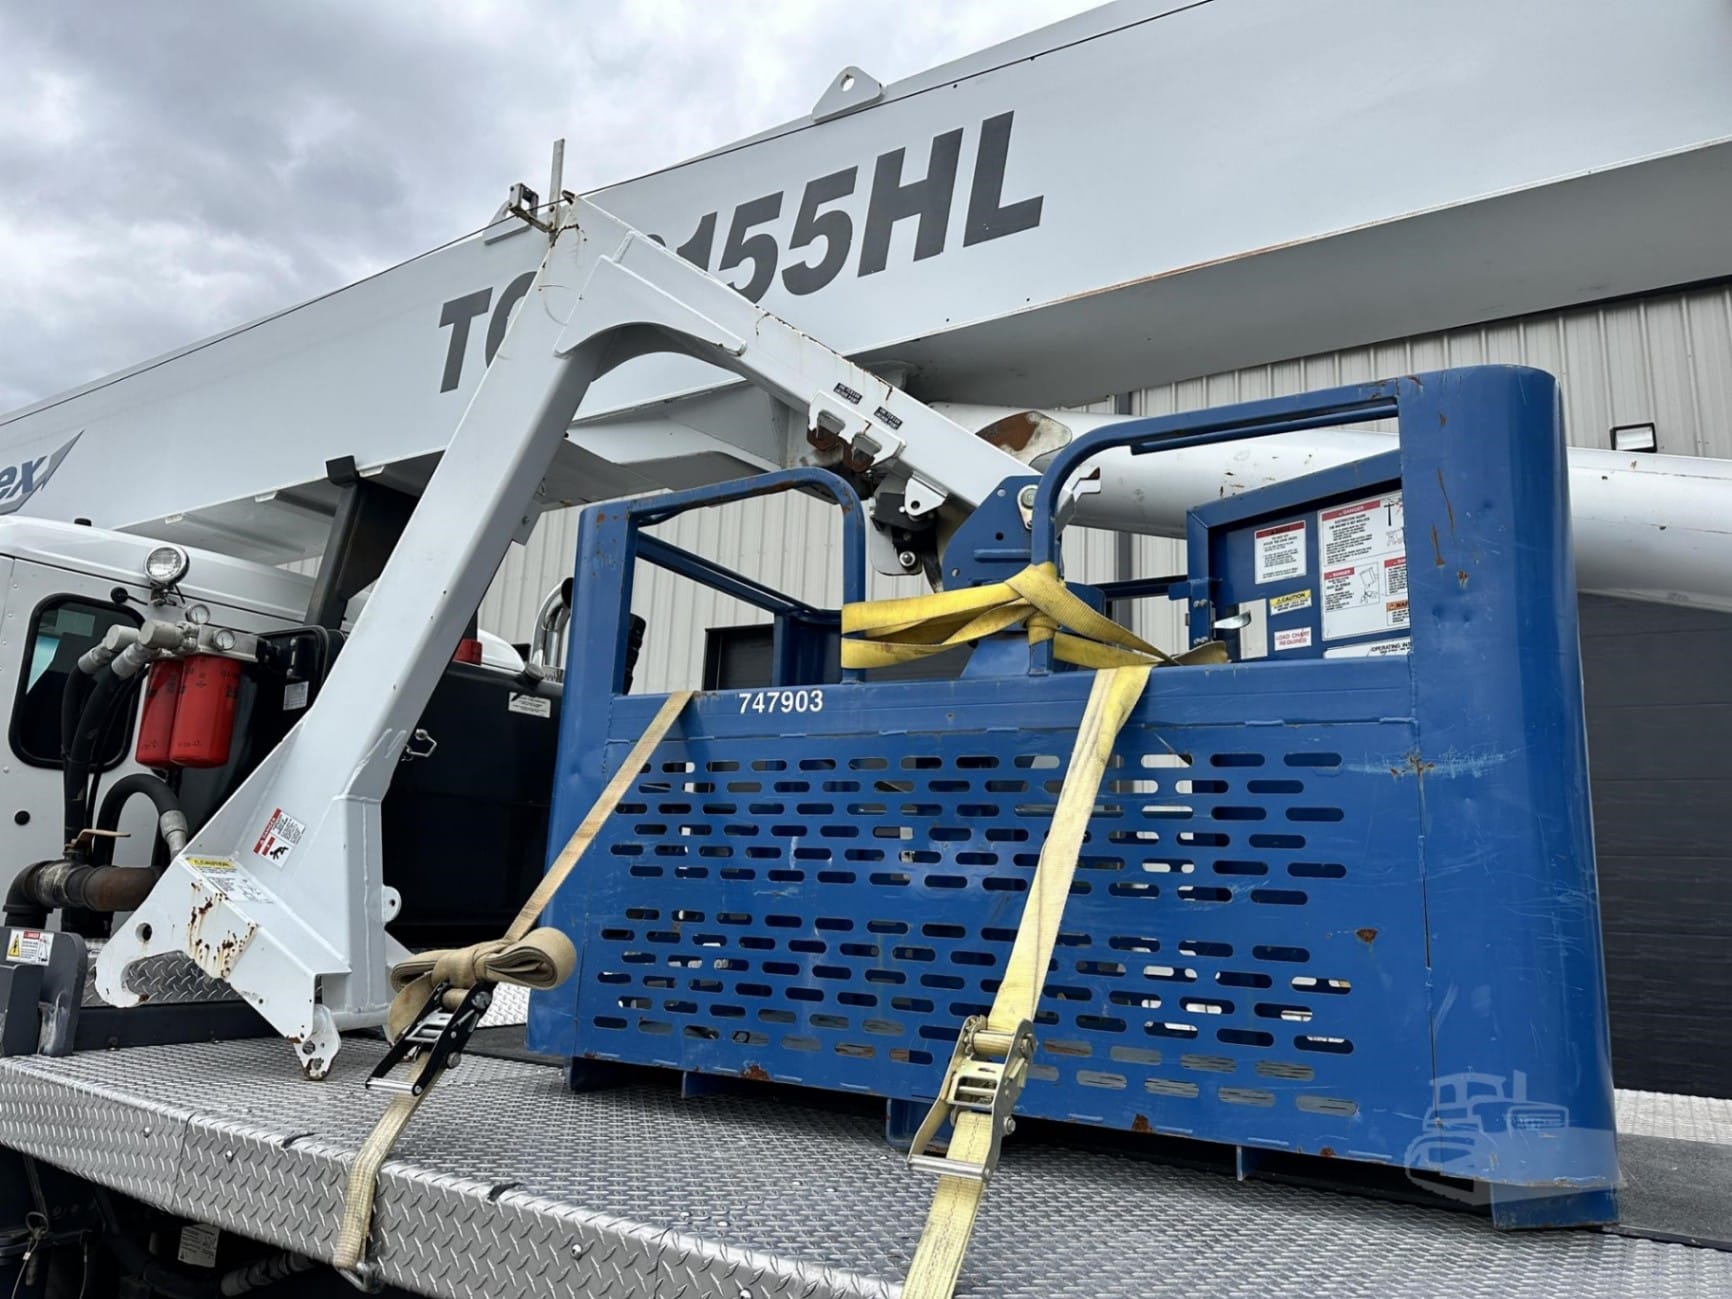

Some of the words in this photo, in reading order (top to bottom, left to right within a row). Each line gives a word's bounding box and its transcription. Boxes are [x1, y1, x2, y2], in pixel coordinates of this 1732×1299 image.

[646, 110, 1043, 304] 155HL
[1291, 630, 1310, 639] CHART
[1279, 638, 1307, 646] REQUIRED
[1371, 643, 1401, 652] OPERATING
[739, 690, 823, 714] 747903
